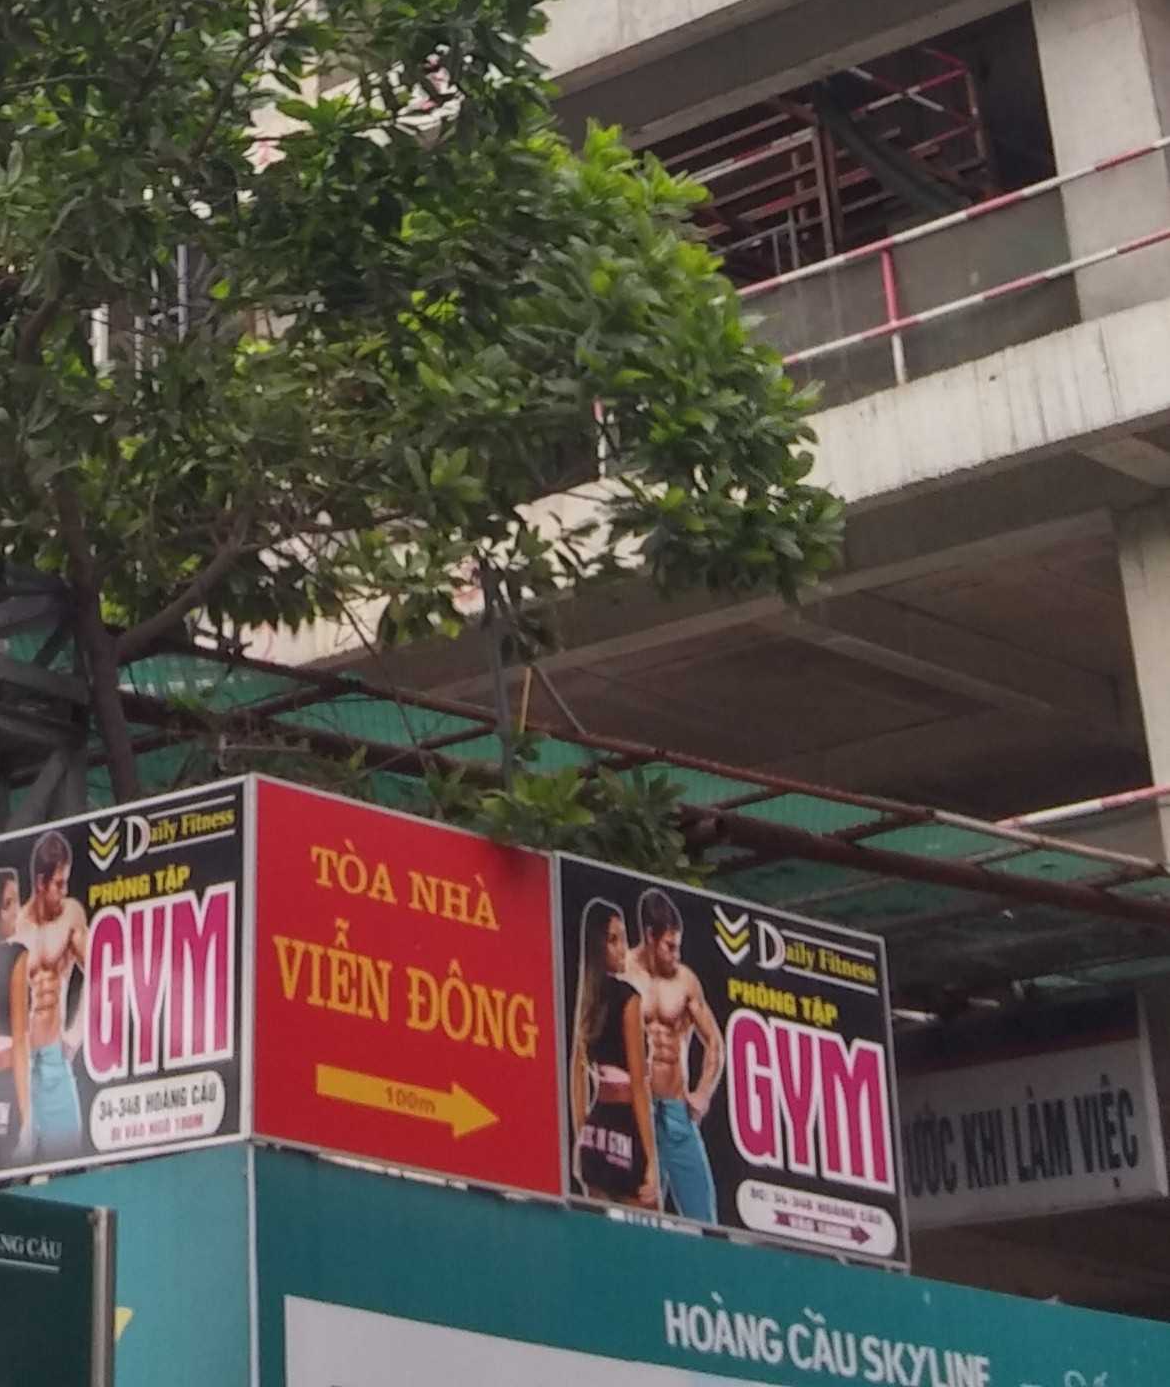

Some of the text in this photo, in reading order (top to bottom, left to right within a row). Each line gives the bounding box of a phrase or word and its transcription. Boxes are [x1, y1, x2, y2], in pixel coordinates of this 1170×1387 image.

[123, 809, 236, 862] Daily Fitness
[154, 863, 191, 895] TẬP
[310, 838, 501, 932] TÒA NHÀ
[85, 882, 236, 1082] GYM
[271, 917, 539, 1060] VIỄN ĐÔNG
[754, 919, 877, 983] Daily Fitness
[799, 995, 839, 1027] TẬP
[384, 1085, 437, 1115] 100m
[726, 1008, 894, 1194] GYM
[961, 1108, 1009, 1191] KHI
[1011, 1084, 1074, 1184] LÀM
[1073, 1073, 1139, 1190] VIỆC
[664, 1290, 990, 1387] HOÀNG CẦU SKYLINE
